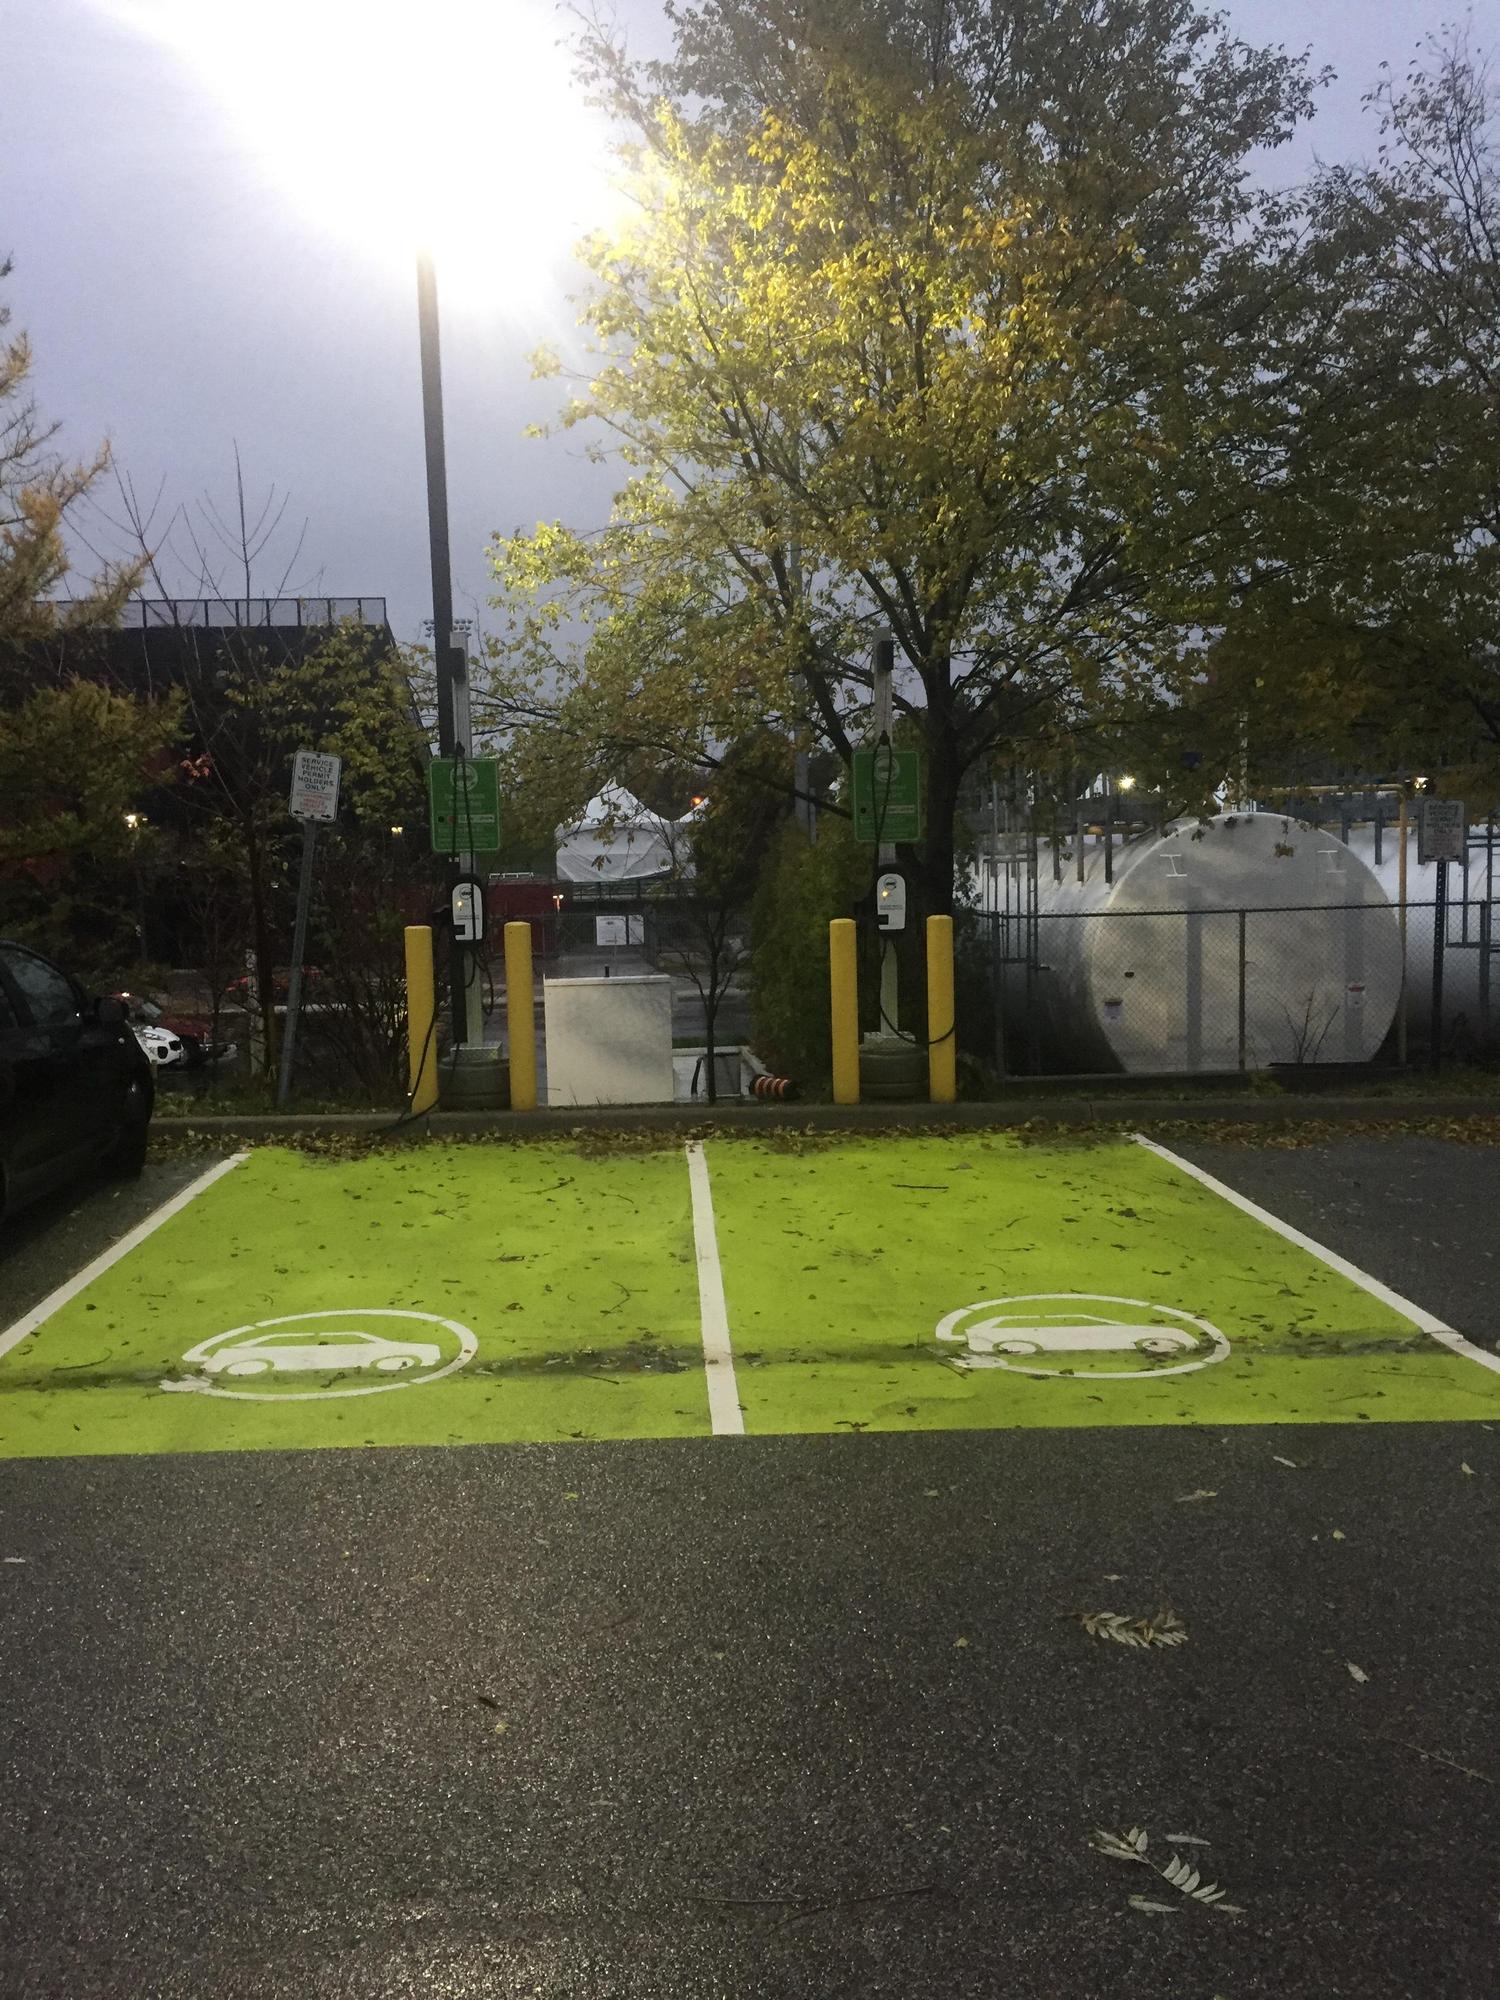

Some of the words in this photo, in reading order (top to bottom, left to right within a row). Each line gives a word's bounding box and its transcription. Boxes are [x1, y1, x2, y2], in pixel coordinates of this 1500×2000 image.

[302, 757, 333, 767] SERVICE
[302, 764, 333, 774] VEHICLE
[303, 770, 330, 779] PERMIT
[298, 776, 334, 786] HOLDERS
